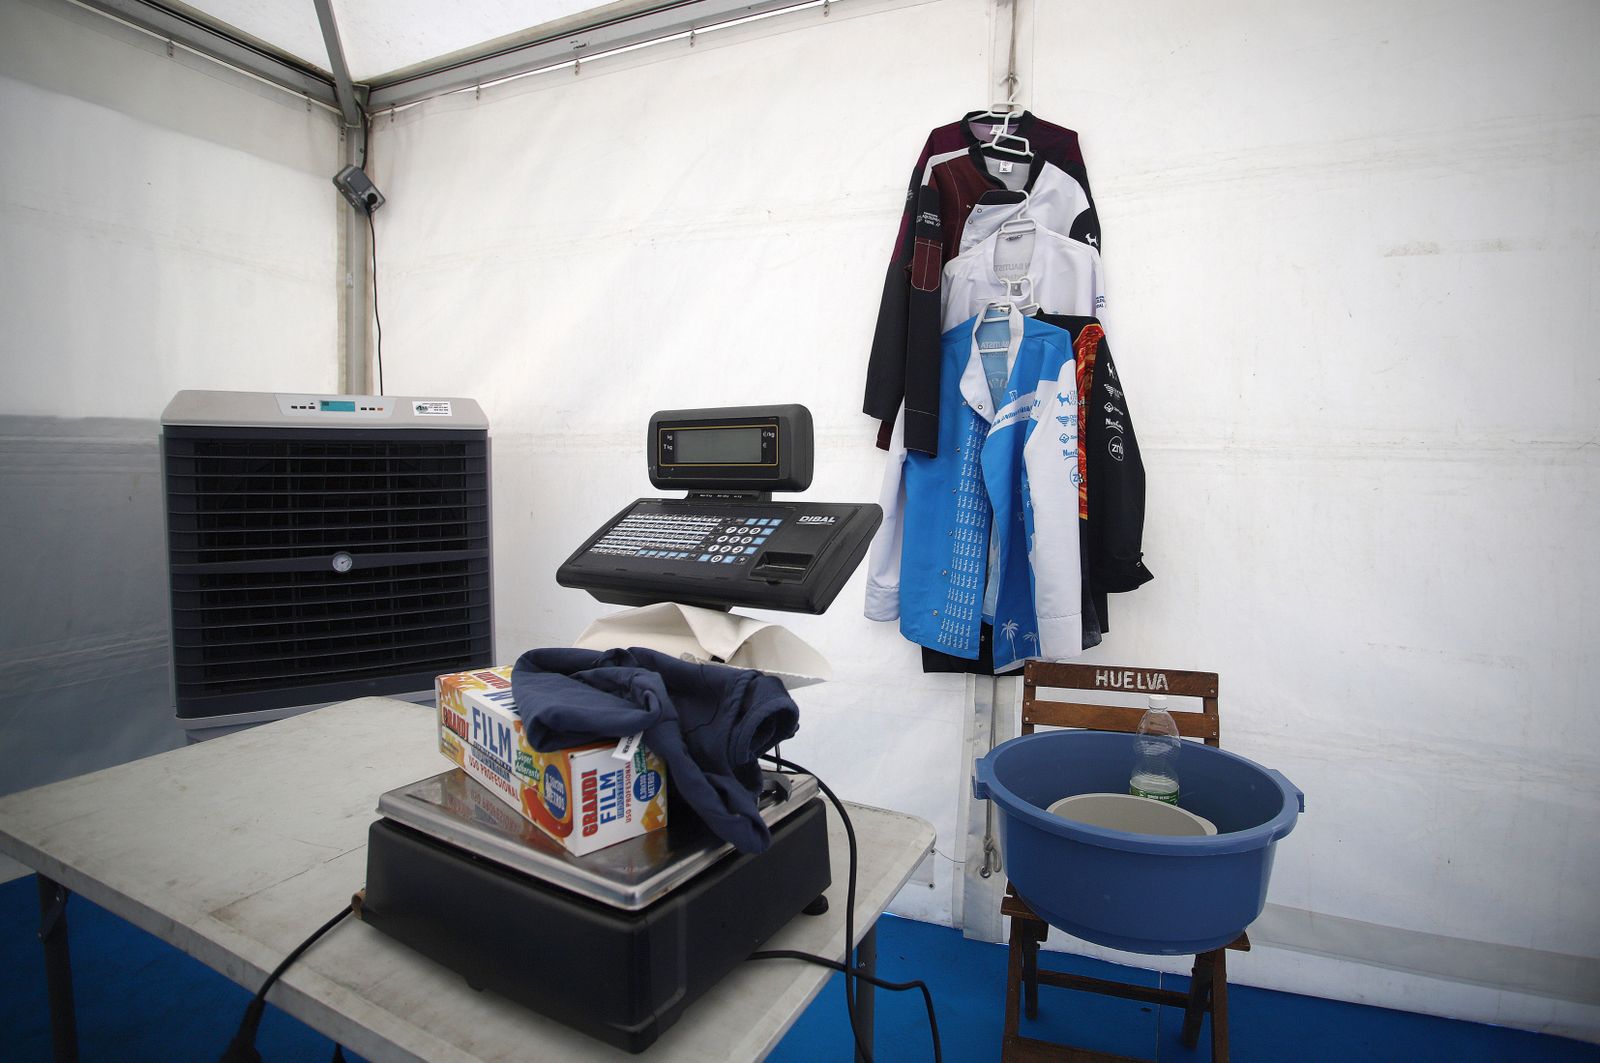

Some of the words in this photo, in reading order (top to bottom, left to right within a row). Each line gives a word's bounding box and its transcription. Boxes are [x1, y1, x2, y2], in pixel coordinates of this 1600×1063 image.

[799, 515, 836, 523] DIBAL
[1096, 669, 1169, 691] HUELVA
[472, 705, 512, 763] FILM
[581, 769, 598, 837] GRANDI
[600, 771, 617, 824] FILM
